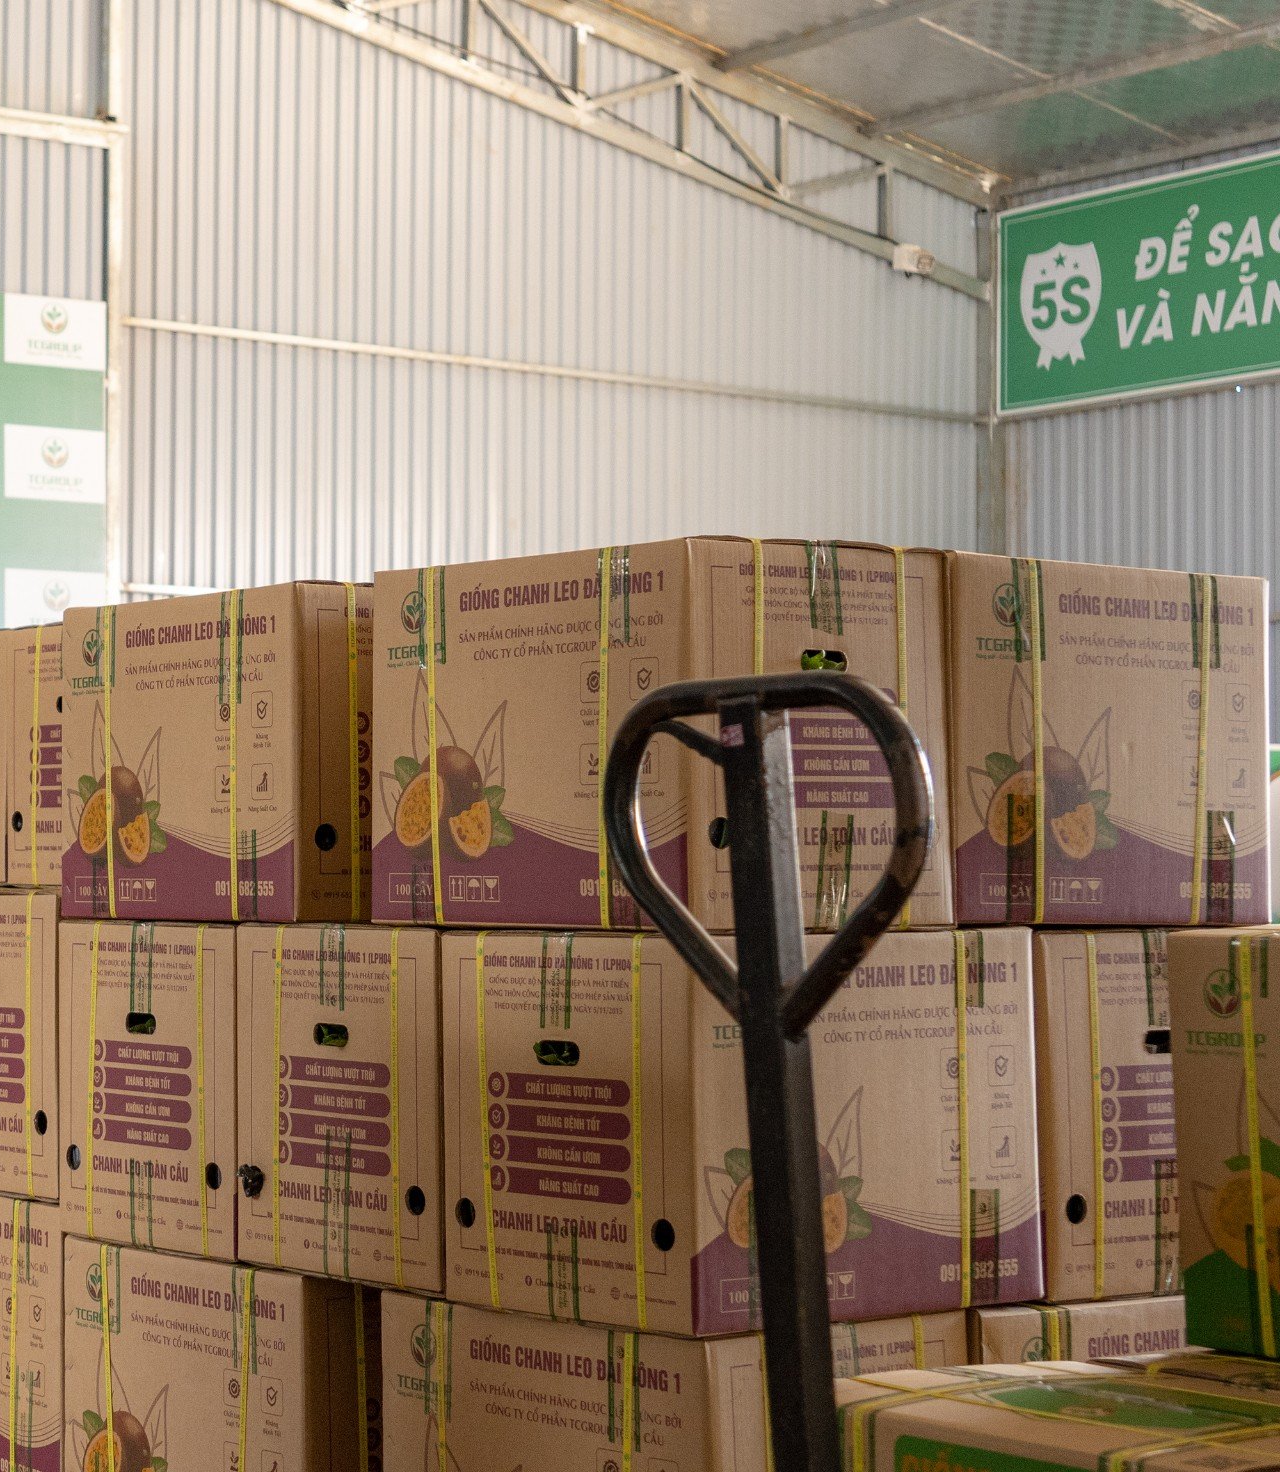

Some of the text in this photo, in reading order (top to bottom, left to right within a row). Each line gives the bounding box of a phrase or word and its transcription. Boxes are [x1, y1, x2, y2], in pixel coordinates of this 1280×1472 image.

[1134, 204, 1199, 282] ĐỂ
[1031, 275, 1091, 330] 5S
[1116, 288, 1174, 349] VÀ
[27, 338, 82, 353] TCGROUP
[460, 571, 664, 612] GIỐNG CHANH LEO 1
[1059, 588, 1100, 616] GIỐNG
[1105, 597, 1150, 620] CHANH
[1155, 599, 1178, 621] LEO
[126, 615, 275, 649] GIỐNG CHANH LEO 1
[459, 630, 476, 644] SẢN
[505, 624, 534, 640] CHÍNH
[474, 646, 499, 661] CÔNG
[501, 647, 512, 659] TY
[155, 679, 163, 690] TY
[802, 721, 830, 740] KHÁNG
[832, 724, 853, 742] BỆNH
[804, 754, 831, 772] KHÔNG
[806, 786, 869, 803] NĂNG SUẤT CAO
[803, 824, 828, 846] LEO
[484, 951, 508, 967] GIỐNG
[510, 955, 536, 968] CHANH
[596, 958, 599, 970] 1
[856, 962, 1017, 989] CHANH LEO 1
[526, 1079, 544, 1094] CHẤT
[547, 1083, 571, 1097] LƯỢNG
[595, 1087, 612, 1101] TRỘI
[537, 1113, 600, 1133] KHÁNG BỆNH TỐT
[538, 1147, 563, 1160] KHÔNG
[93, 1155, 188, 1183] CHANH CẦU
[278, 1180, 388, 1212] CHANH CẦU
[539, 1177, 599, 1197] NĂNG SUẤT CAO
[492, 1210, 628, 1244] CHANH LEO TOÀN CẦU
[131, 1274, 220, 1310] GIỐNG CHANH LEO
[1088, 1324, 1180, 1359] GIỐNG CHANH
[470, 1337, 592, 1379] GIỐNG CHANH LEO
